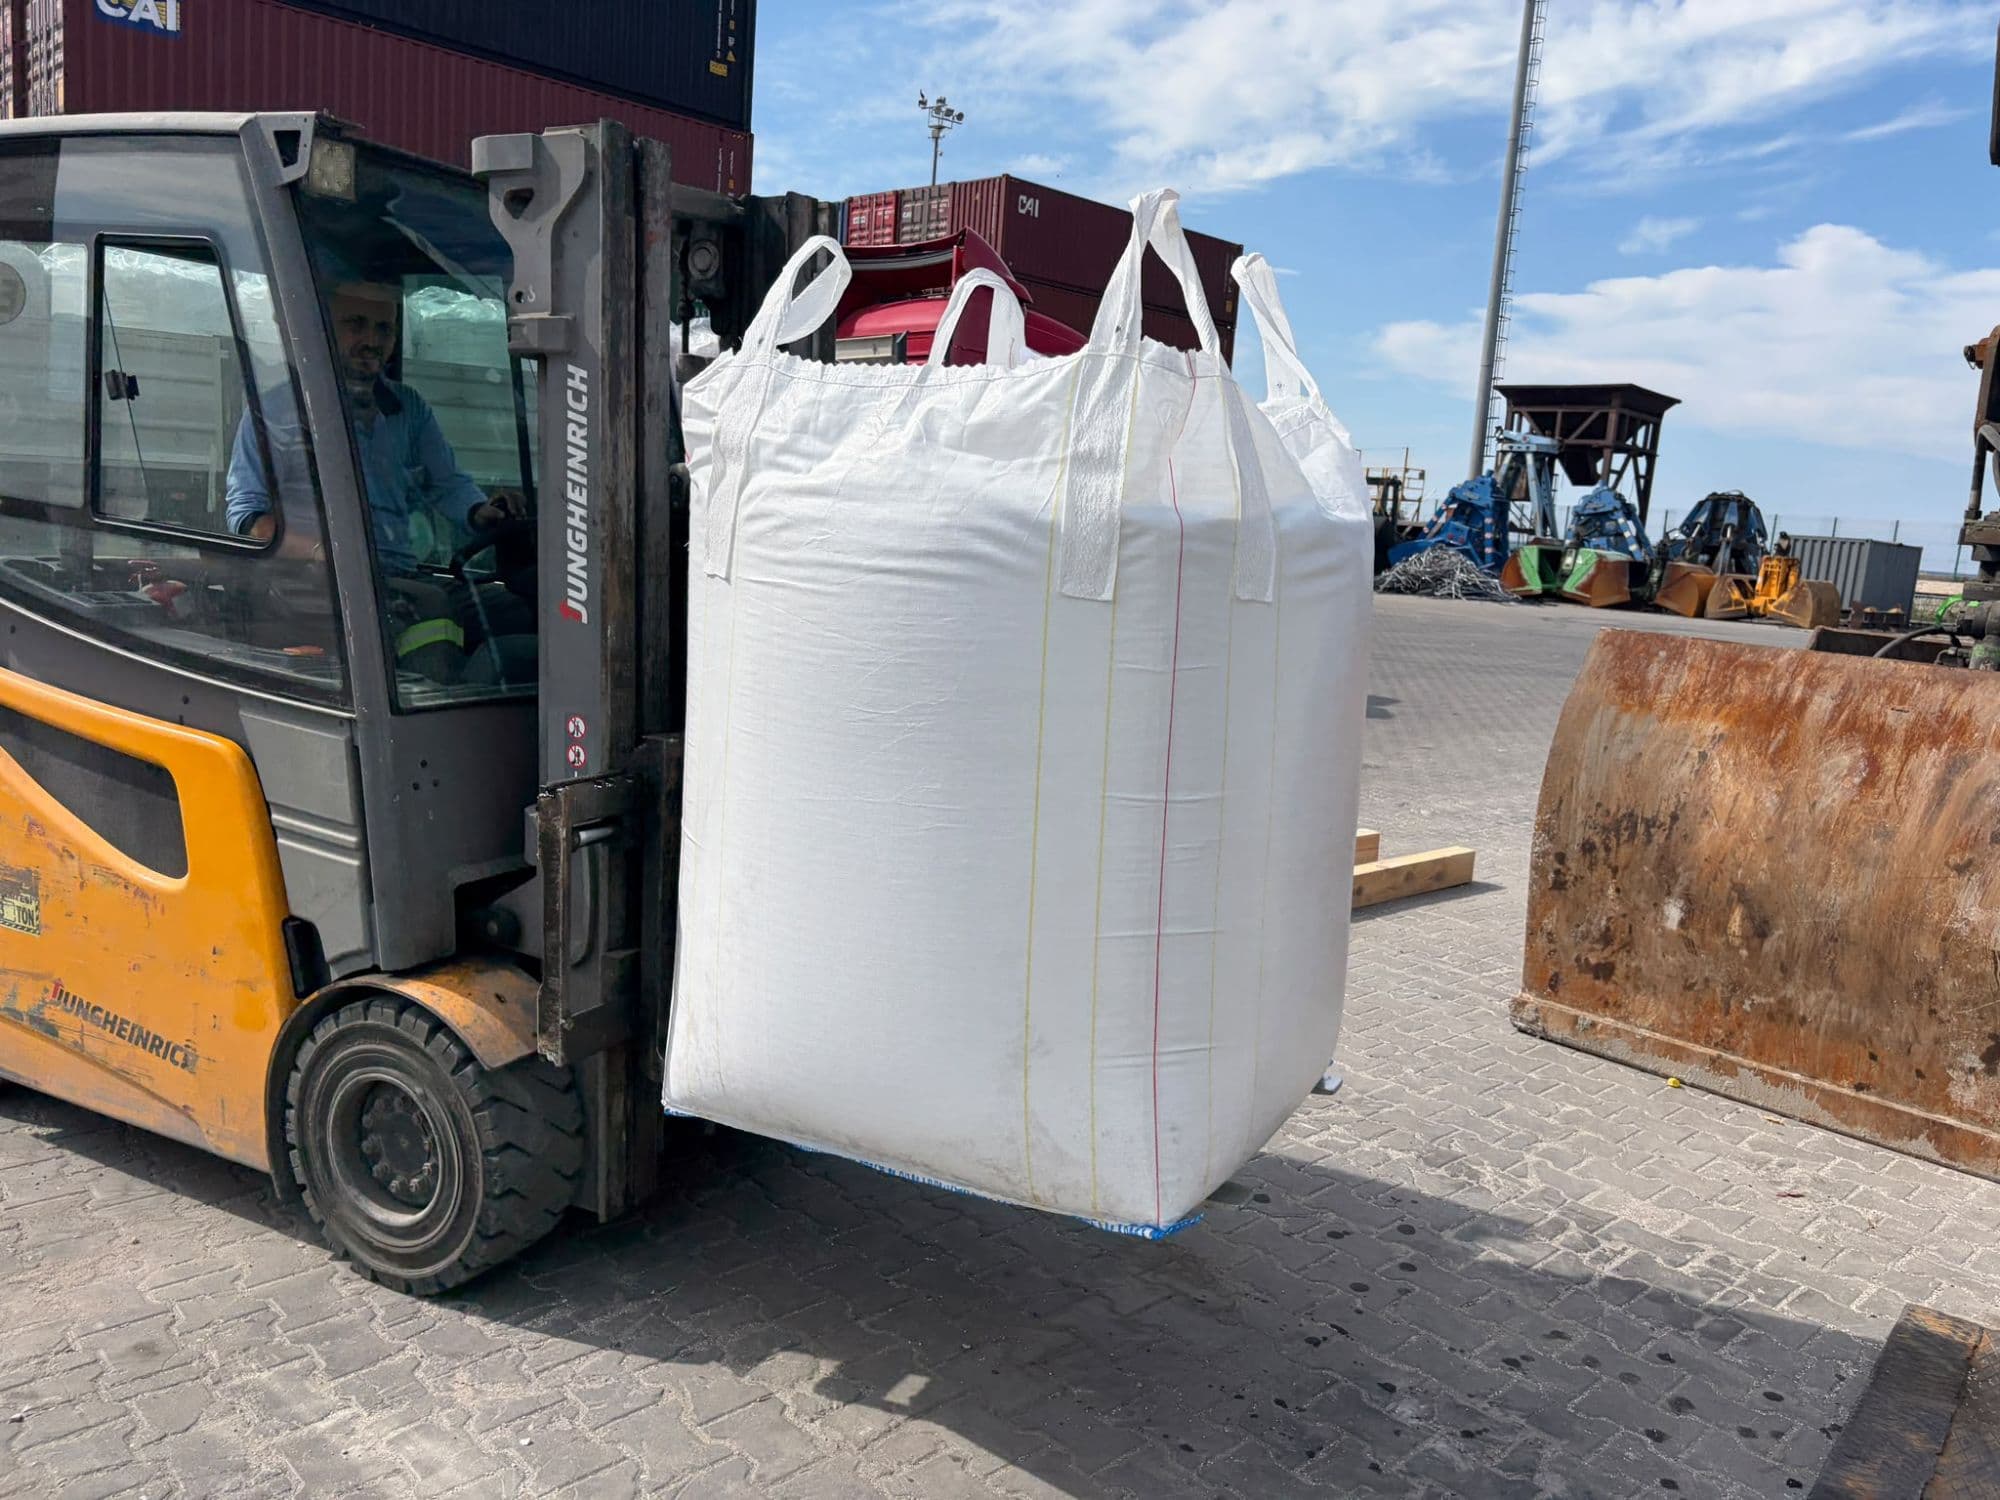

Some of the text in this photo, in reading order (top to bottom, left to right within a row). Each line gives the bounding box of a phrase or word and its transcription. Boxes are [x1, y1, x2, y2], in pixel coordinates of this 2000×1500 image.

[1018, 195, 1040, 218] CAI
[560, 364, 588, 624] JUNGHEINRICH
[16, 905, 35, 927] TON
